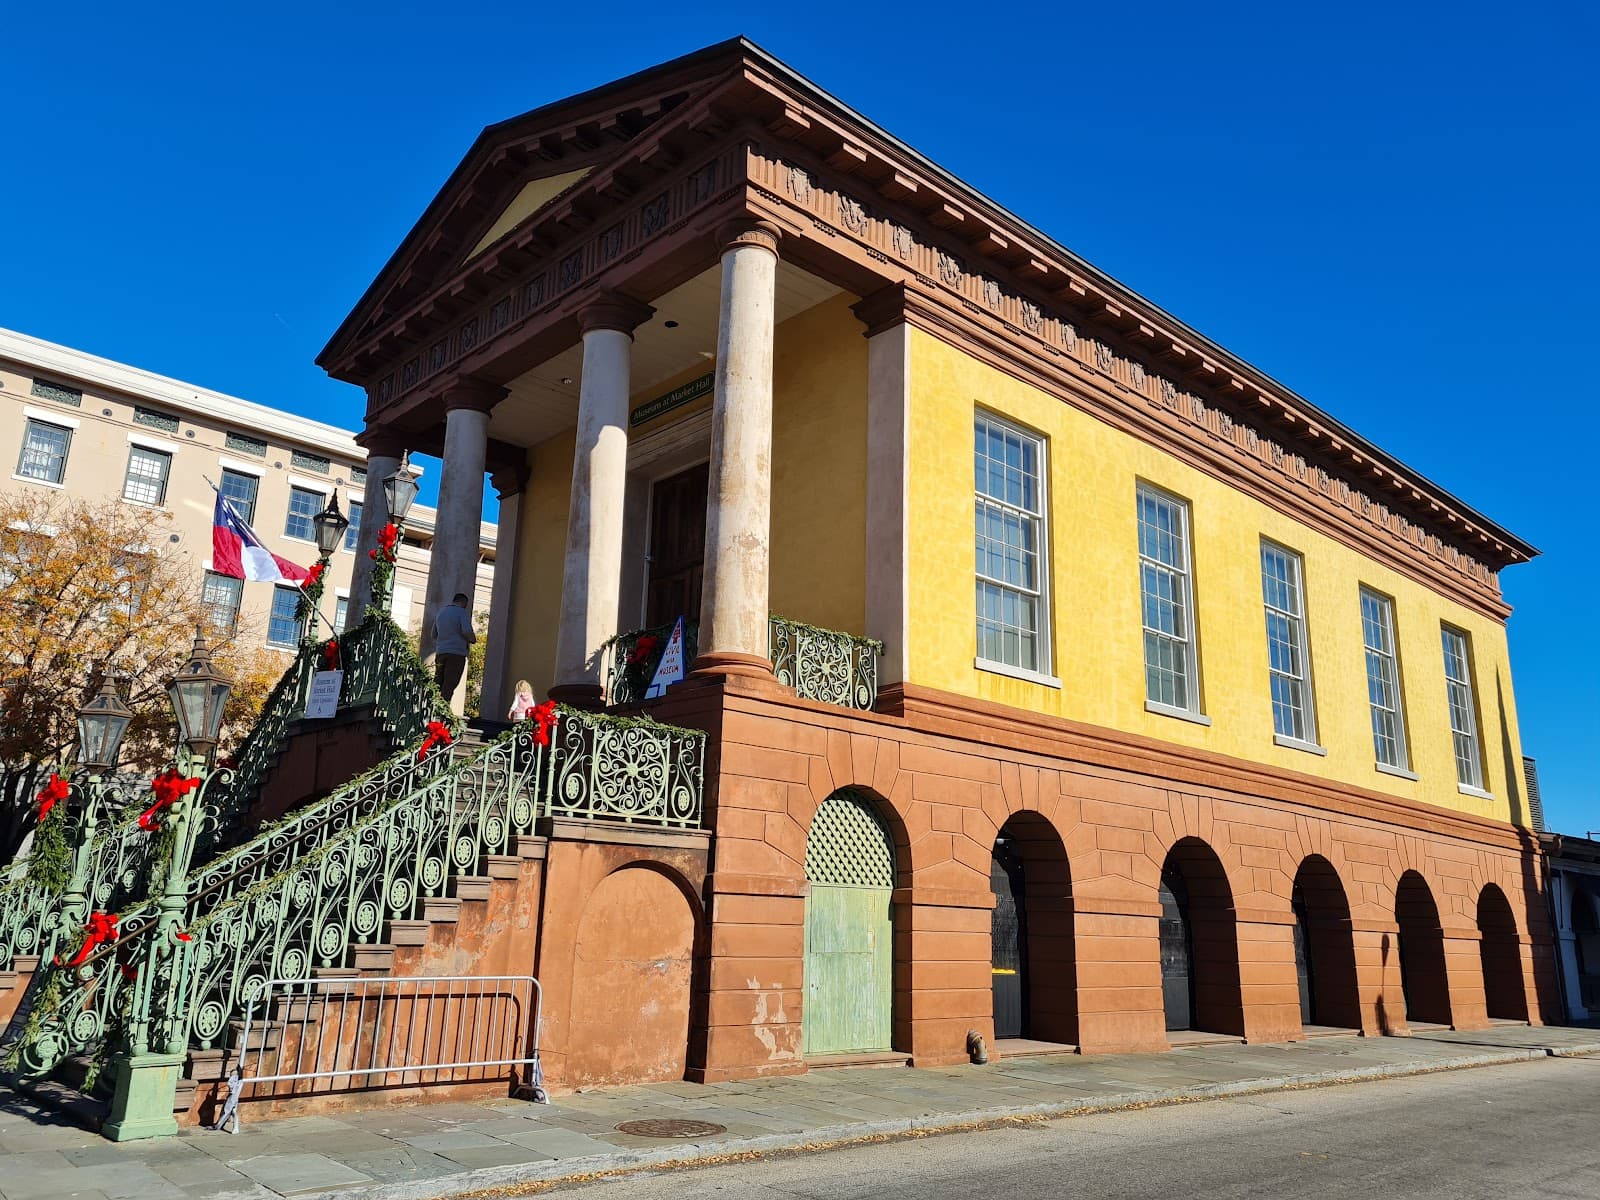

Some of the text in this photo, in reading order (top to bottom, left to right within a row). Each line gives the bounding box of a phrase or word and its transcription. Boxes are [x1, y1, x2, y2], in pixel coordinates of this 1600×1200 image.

[634, 377, 710, 420] Museum at Market Hall
